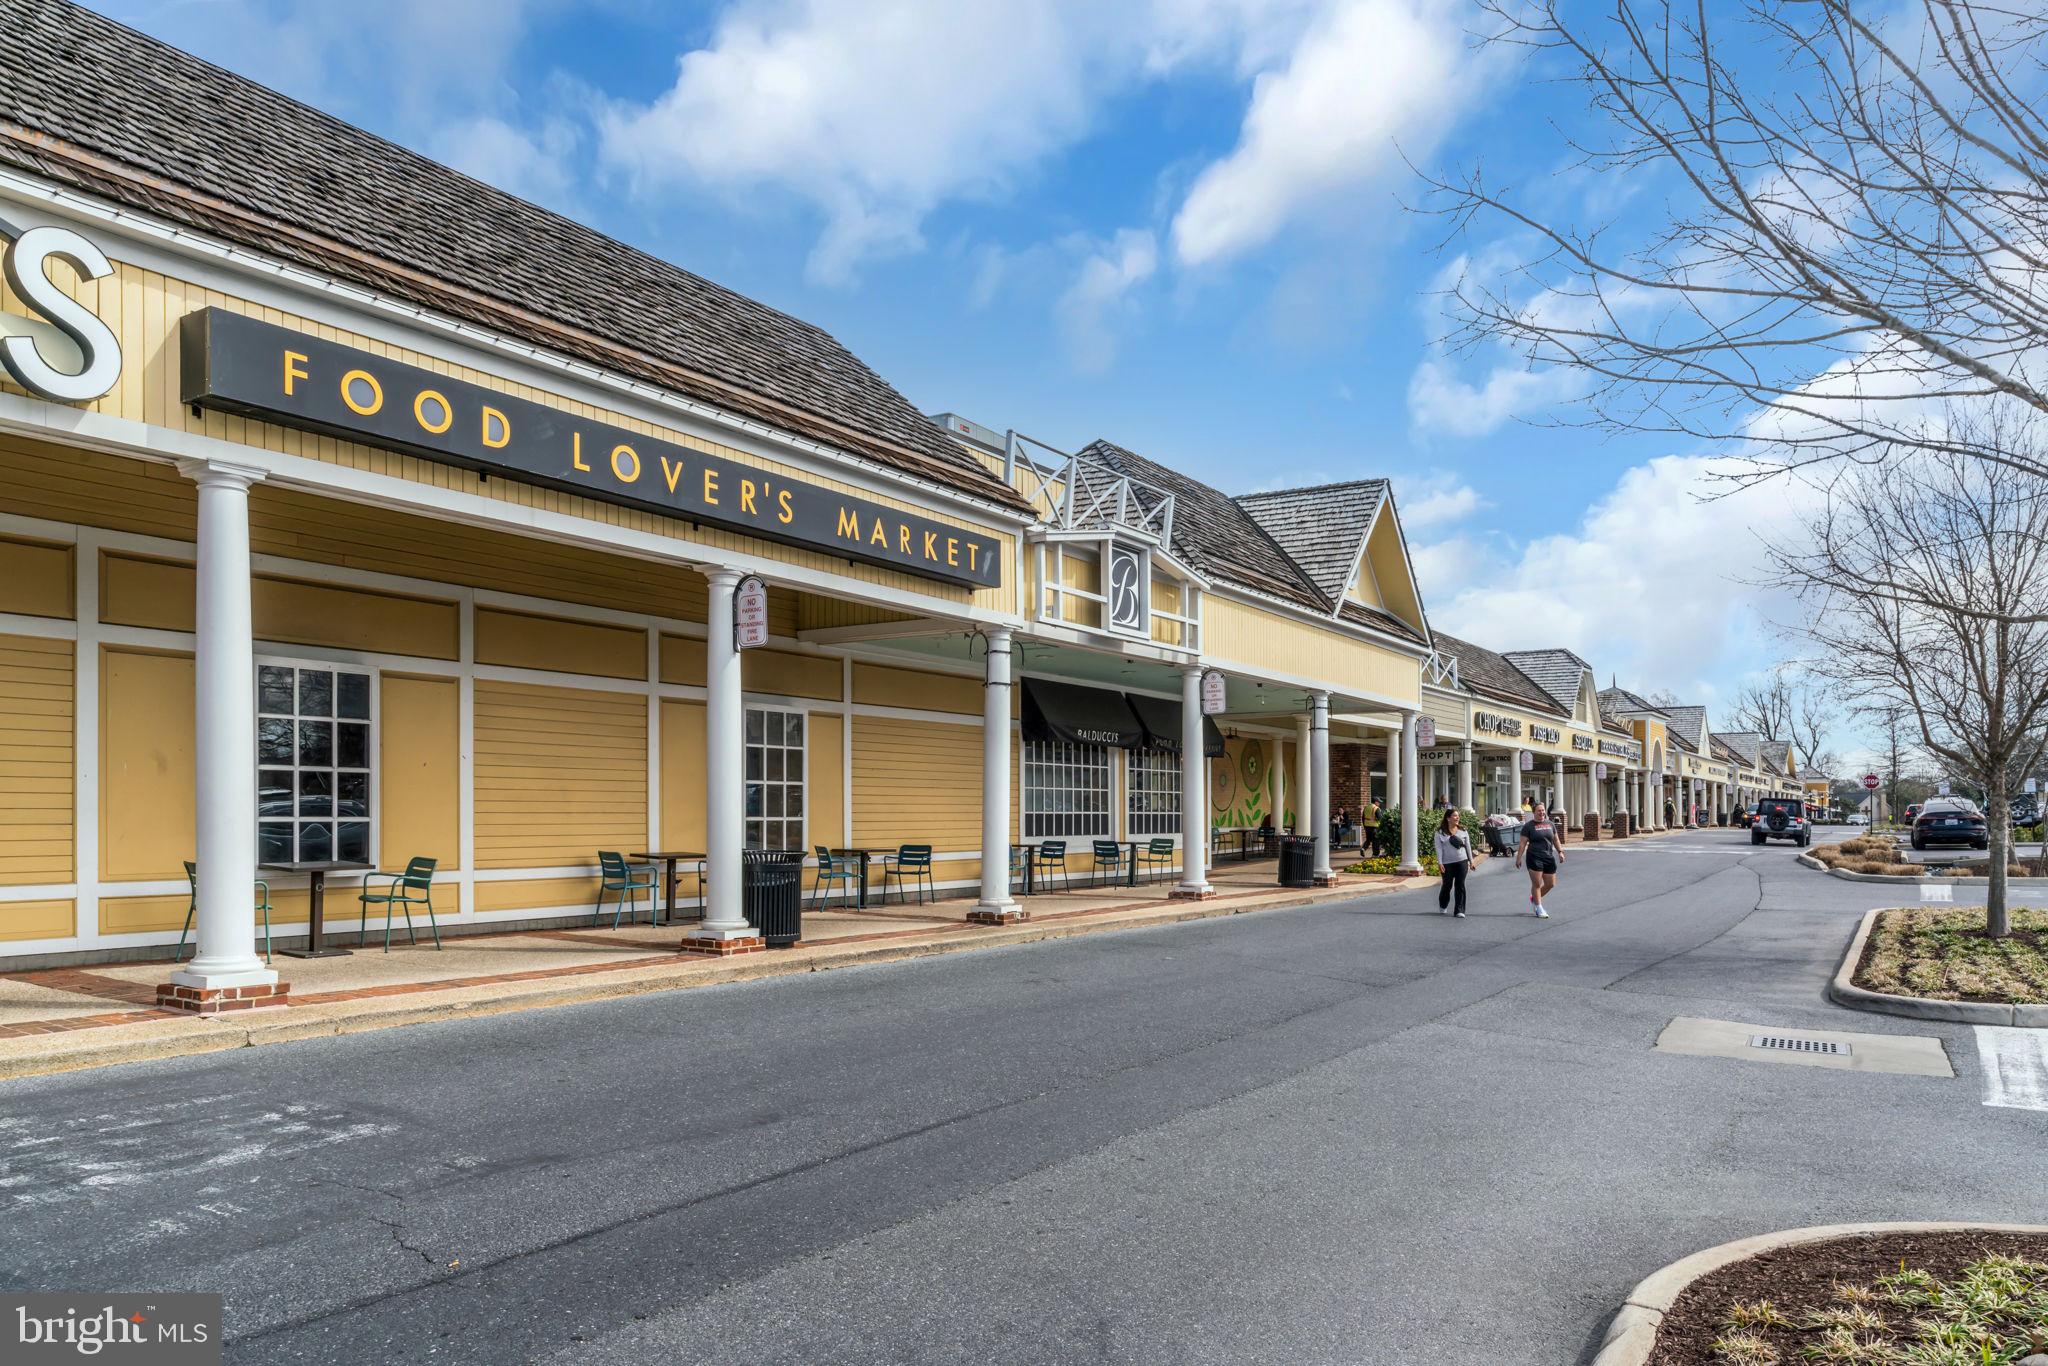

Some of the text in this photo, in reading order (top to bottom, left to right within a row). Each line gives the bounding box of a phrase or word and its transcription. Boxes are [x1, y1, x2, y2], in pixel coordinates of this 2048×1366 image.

[284, 350, 979, 571] FOOD LOVER'S MARKET
[747, 598, 757, 606] NO
[1111, 555, 1139, 624] B
[1863, 778, 1880, 786] STOP
